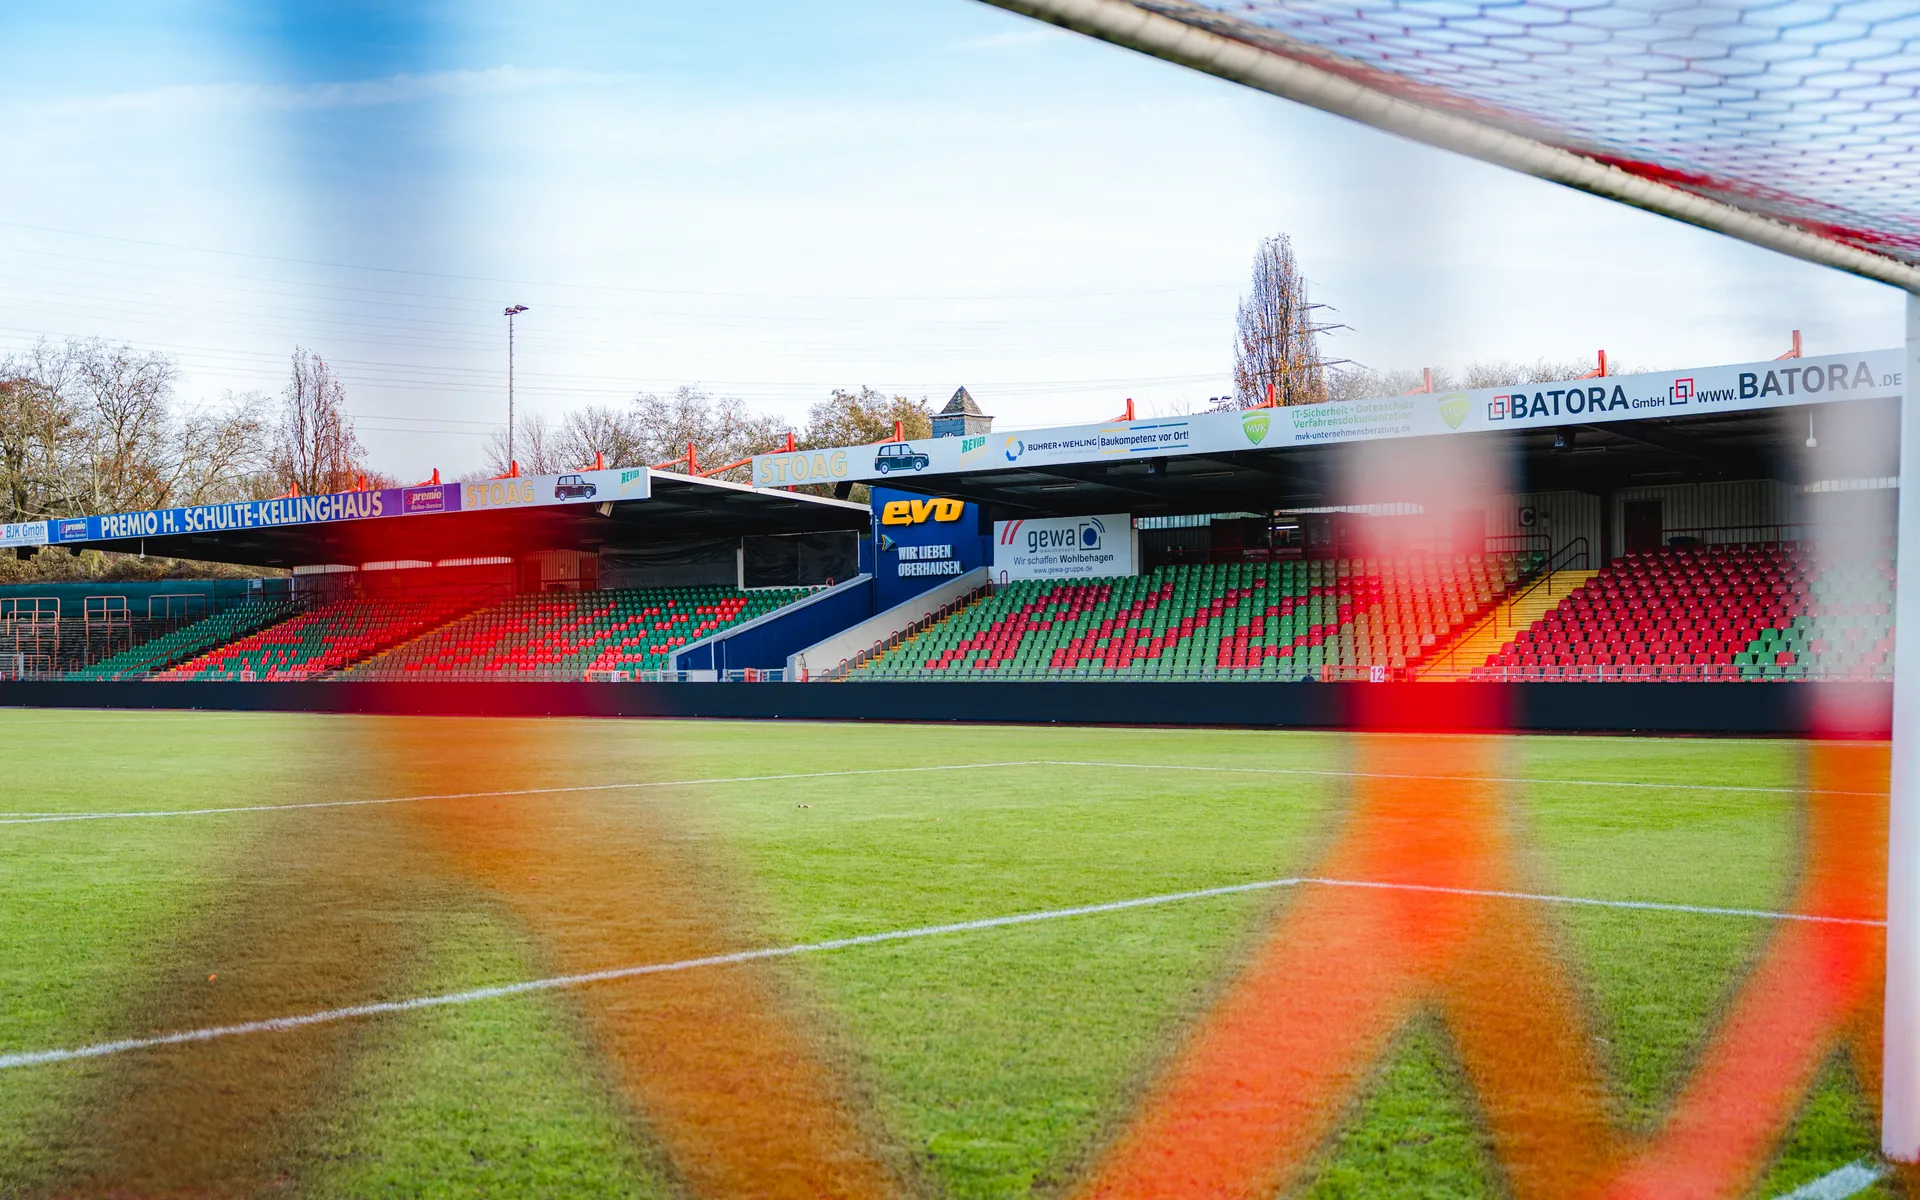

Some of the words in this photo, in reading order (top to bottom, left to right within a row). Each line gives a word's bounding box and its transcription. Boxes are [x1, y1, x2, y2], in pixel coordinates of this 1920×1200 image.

[1292, 406, 1348, 419] IT-Sicherheit
[1356, 401, 1414, 413] Datenschutz
[1511, 384, 1630, 419] BATORA
[1632, 396, 1665, 409] GmbH
[1247, 423, 1267, 433] MVK
[1293, 411, 1413, 428] Verfahrensdokumentation
[1100, 433, 1156, 448] Baukompetenz
[1158, 433, 1172, 442] vor
[1174, 430, 1189, 441] Ort!
[1295, 424, 1411, 441] mvk-unternehmensberatung.de
[961, 436, 986, 454] REVIER
[760, 450, 848, 483] STOAG
[412, 488, 442, 505] premio
[466, 479, 535, 508] STOAG
[101, 511, 158, 538] PREMIO
[163, 513, 180, 533] H.
[185, 491, 383, 531] SCHULTE-KELLINGHAUS
[882, 497, 964, 526] evo
[1519, 508, 1534, 526] C
[6, 524, 20, 538] BJK
[22, 523, 45, 537] Gmbh
[66, 520, 86, 534] premio
[1028, 528, 1075, 553] gewa
[898, 546, 918, 560] WIR
[919, 544, 952, 560] LIEBEN
[1013, 556, 1026, 565] Wir
[1027, 555, 1058, 565] schaffen
[1059, 553, 1114, 564] Wohlbehagen
[898, 560, 963, 577] OBERHAUSEN.
[1034, 564, 1093, 575] www.gewa-gruppe.de
[612, 671, 620, 682] 10
[1371, 667, 1384, 681] 12
